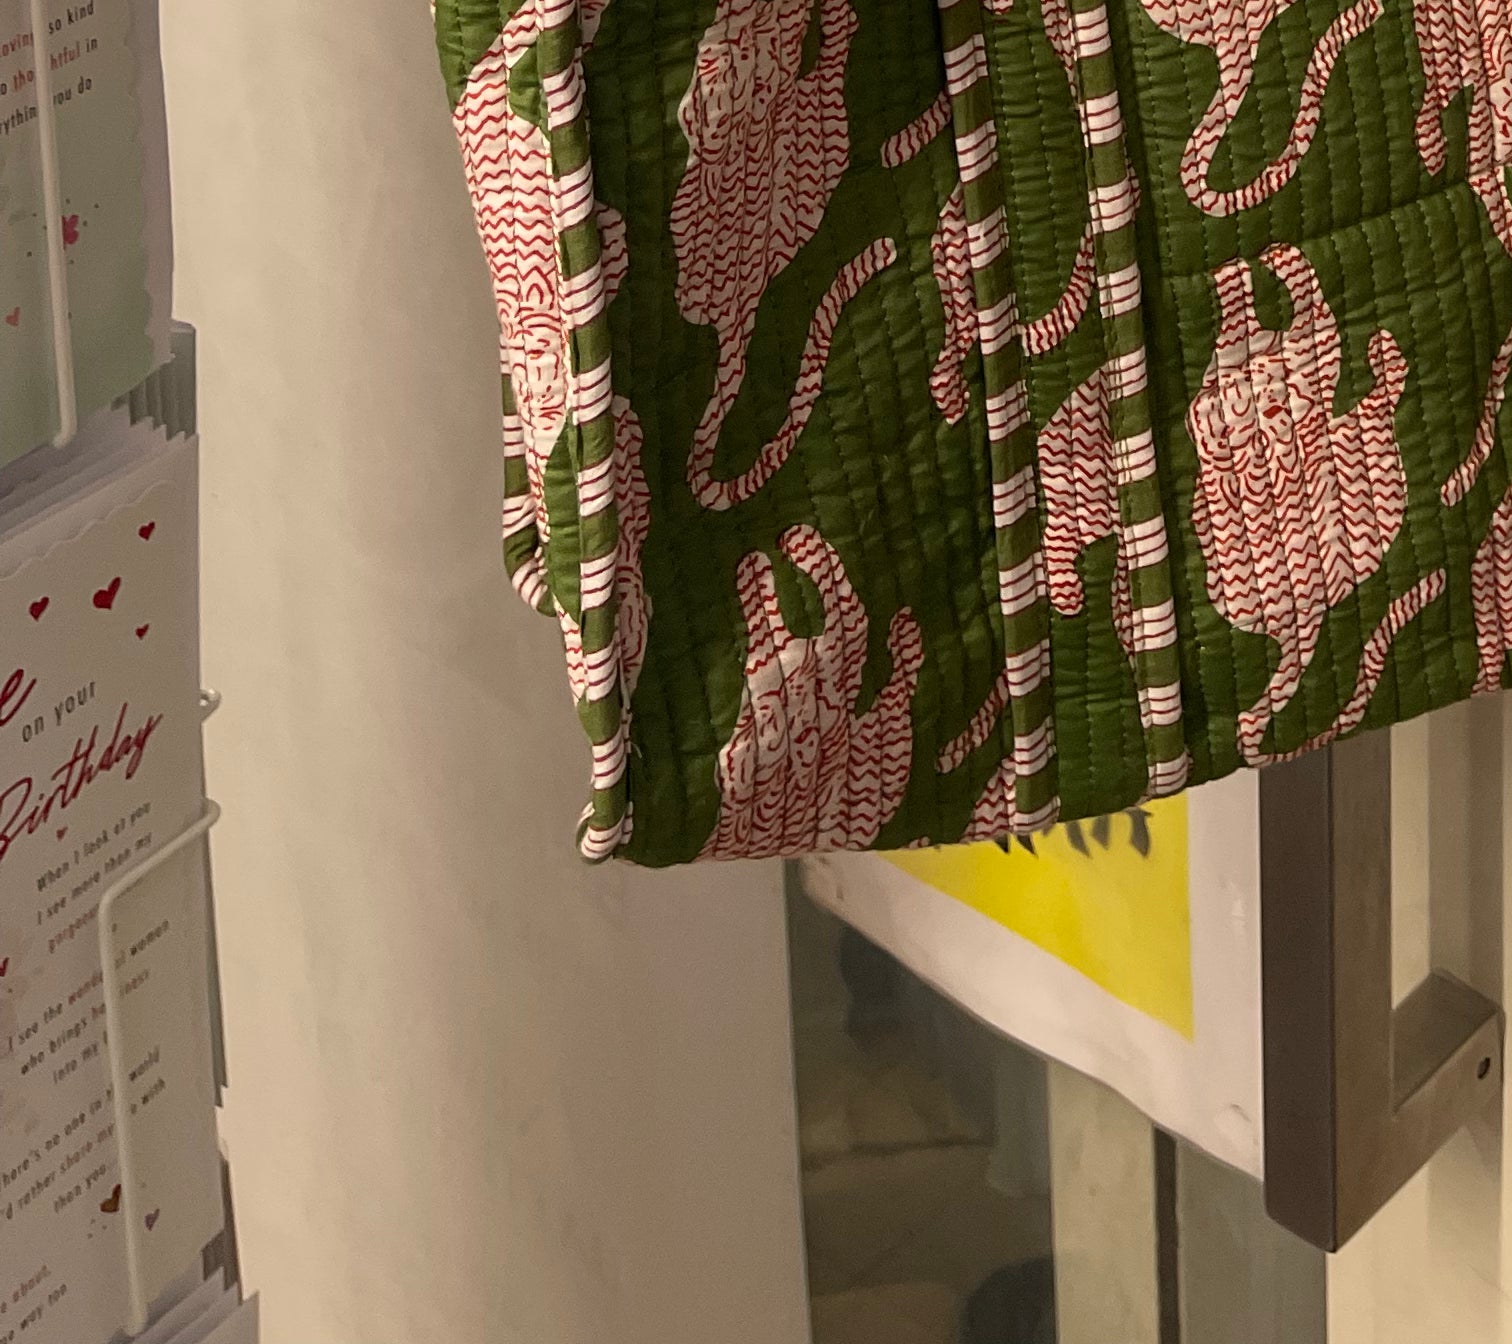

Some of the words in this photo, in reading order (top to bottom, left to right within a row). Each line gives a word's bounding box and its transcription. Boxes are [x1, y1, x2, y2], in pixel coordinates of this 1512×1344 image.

[48, 18, 62, 34] so
[13, 40, 81, 92] thohtful
[85, 37, 98, 53] in
[77, 75, 93, 94] do
[22, 715, 45, 743] on
[53, 680, 96, 727] your
[18, 1021, 39, 1046] see
[43, 1002, 63, 1024] the
